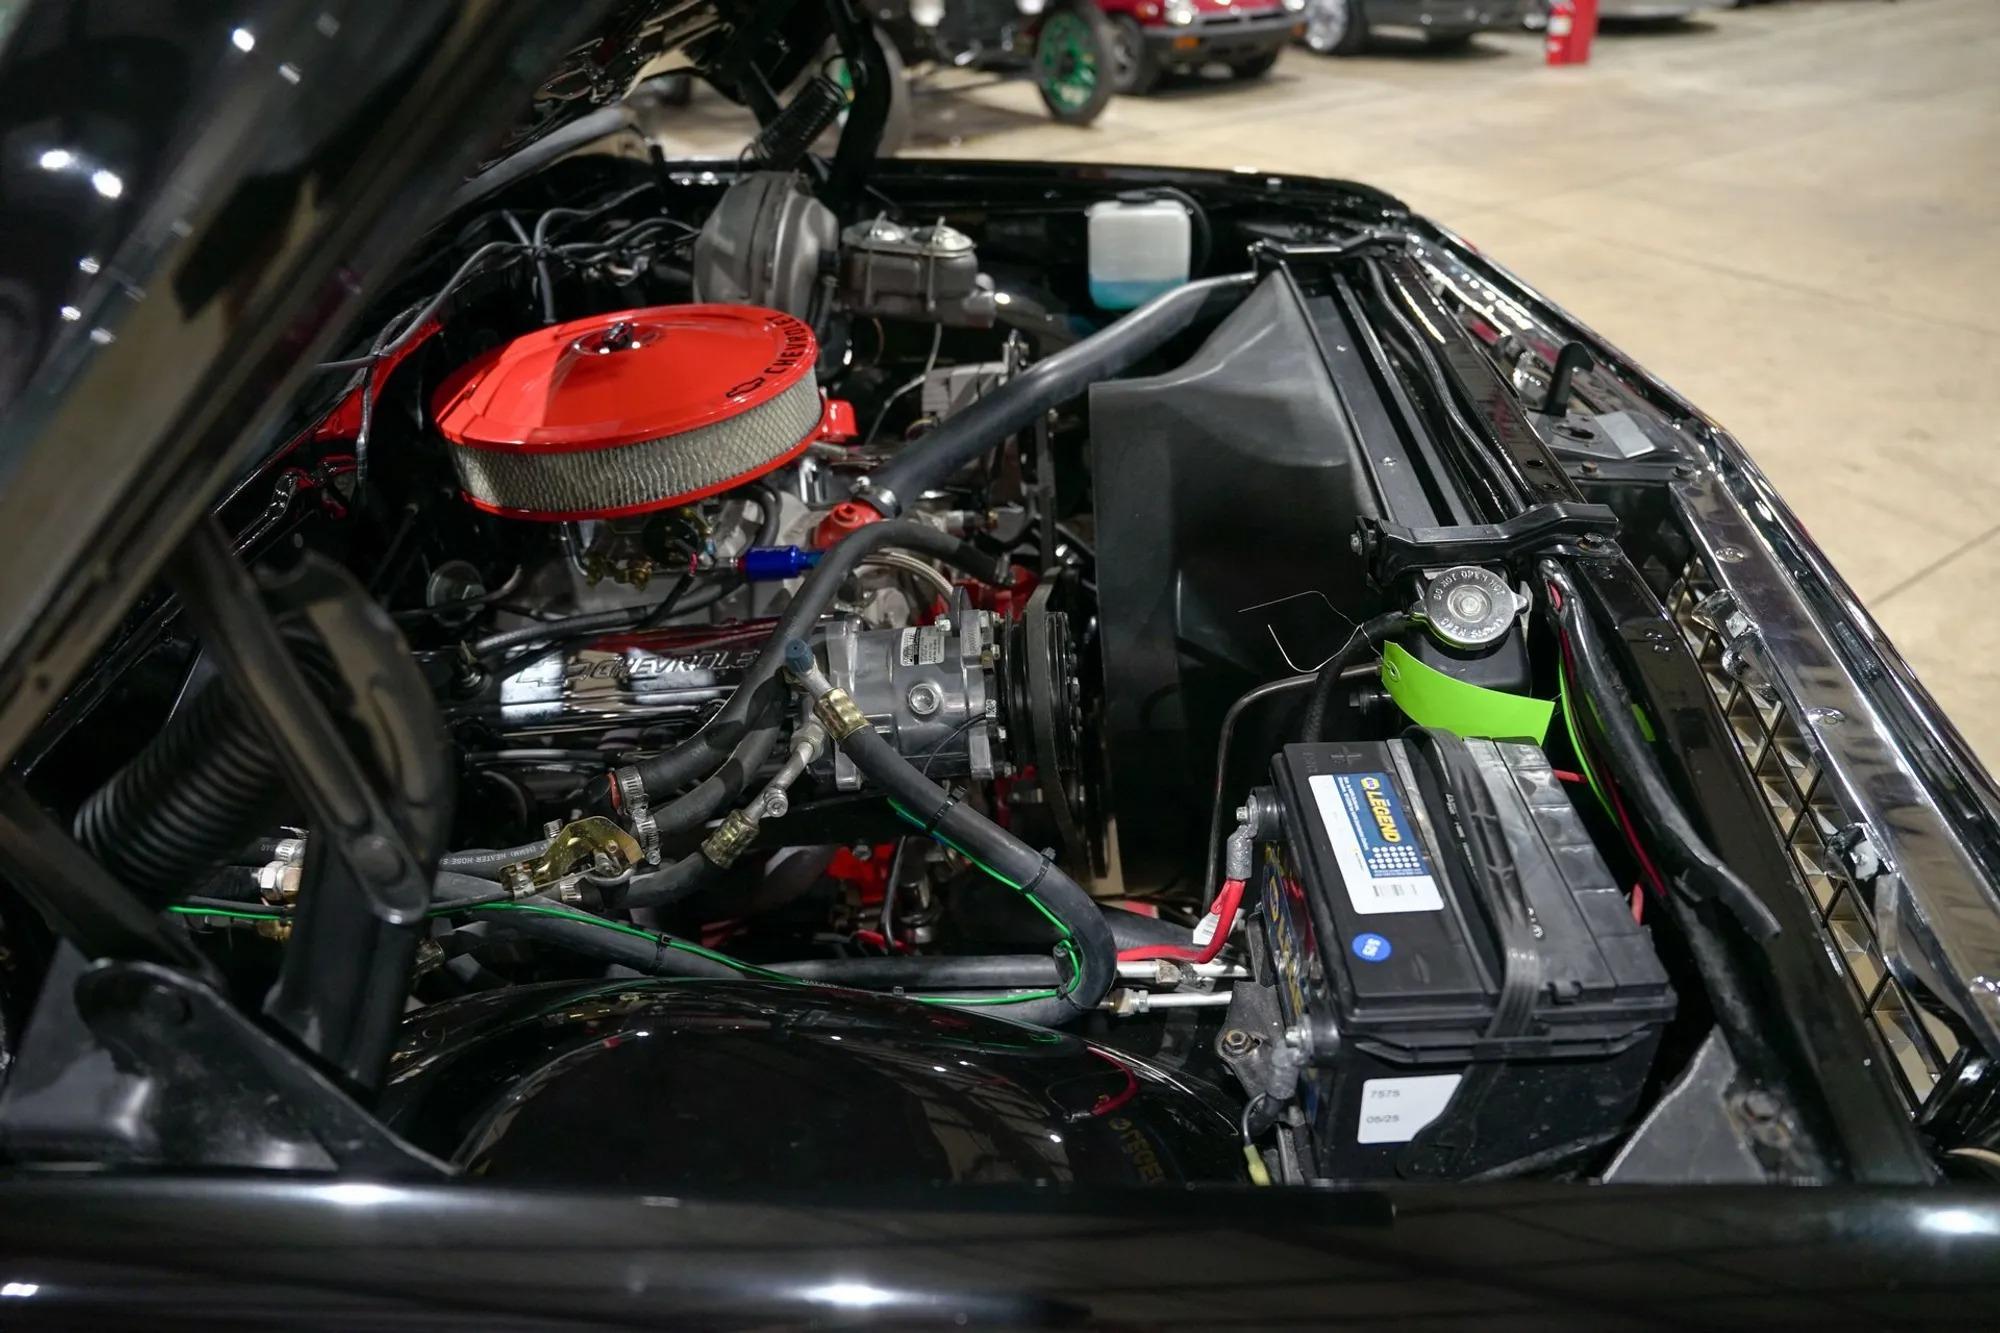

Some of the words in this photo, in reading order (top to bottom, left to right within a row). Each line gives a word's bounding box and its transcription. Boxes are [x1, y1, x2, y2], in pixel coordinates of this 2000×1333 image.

[764, 314, 809, 374] CHEVROLET
[1433, 588, 1443, 600] DO
[1441, 573, 1457, 588] NOT
[1461, 570, 1489, 582] OPEN
[1440, 618, 1467, 637] OPEN
[592, 650, 761, 679] CHEVROLE
[1366, 791, 1402, 843] LEGEND
[451, 856, 473, 865] HOSE
[476, 852, 506, 863] HEATER
